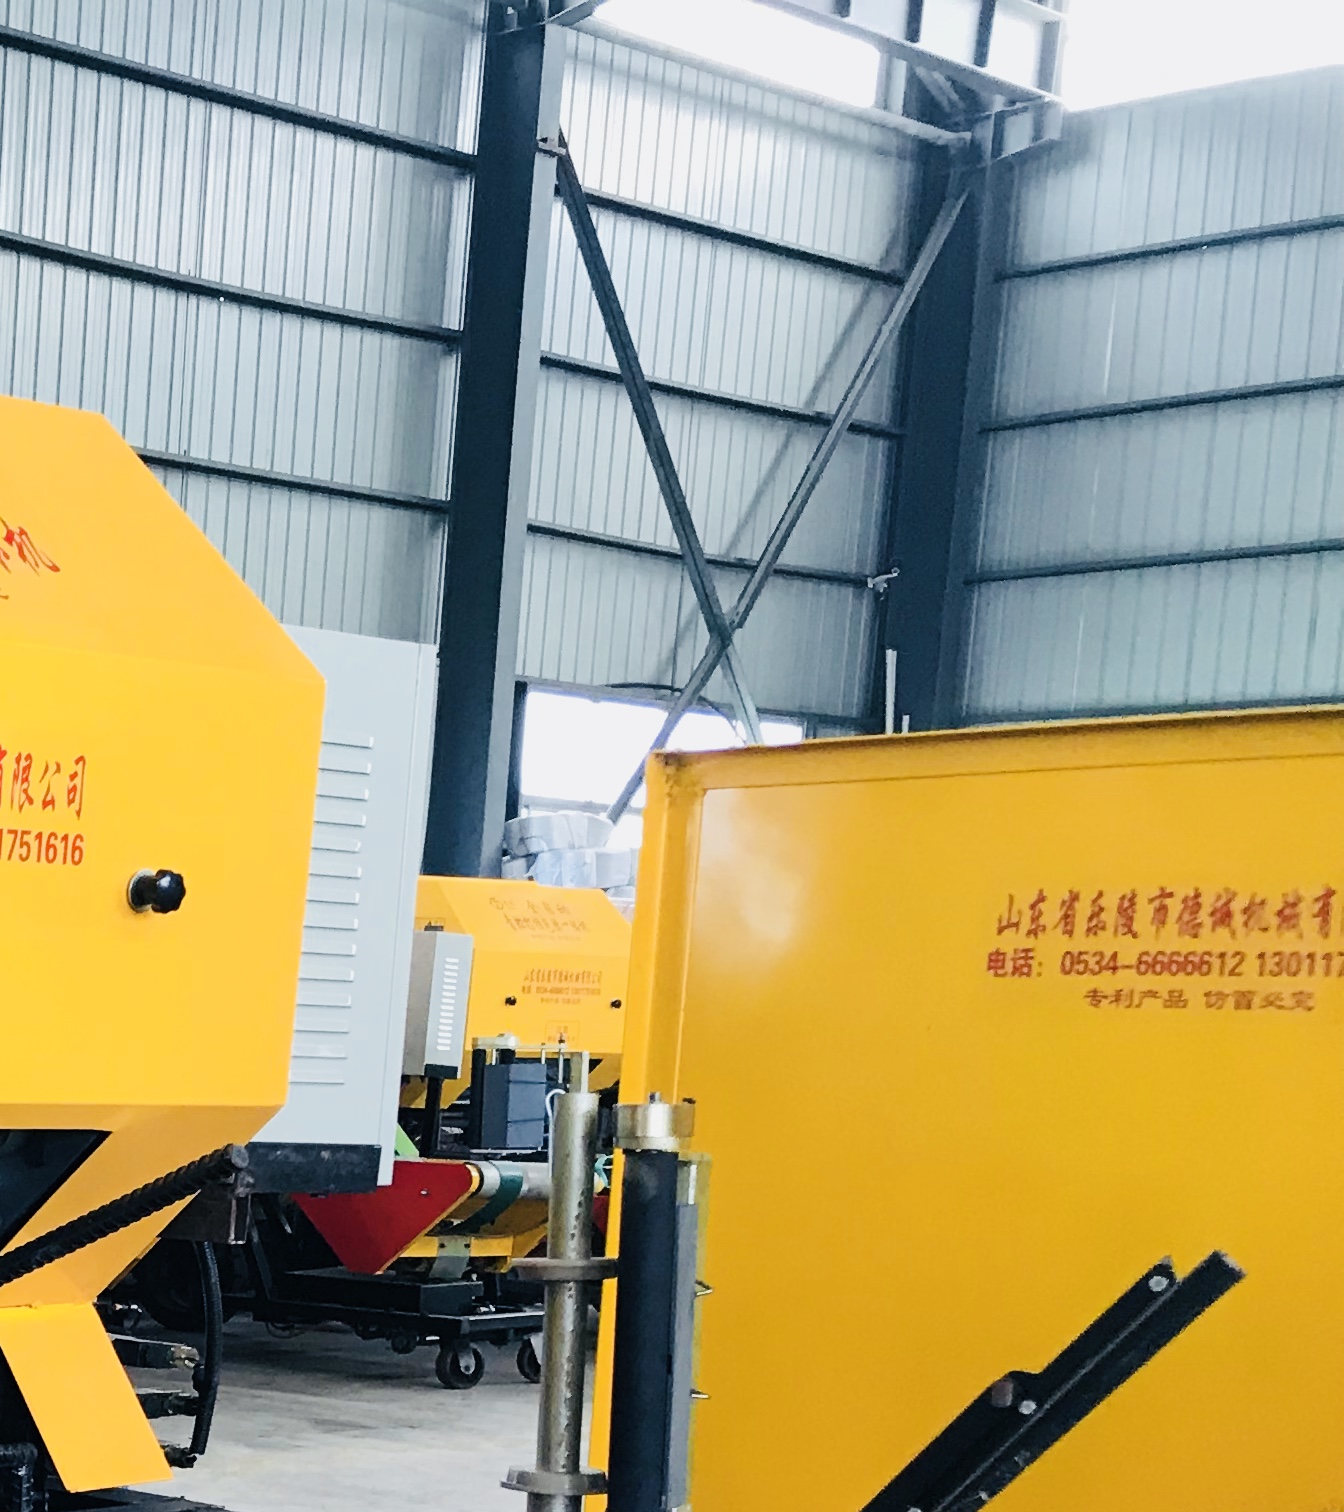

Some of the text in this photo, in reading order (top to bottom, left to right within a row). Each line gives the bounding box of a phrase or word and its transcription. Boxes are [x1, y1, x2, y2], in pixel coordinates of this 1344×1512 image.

[997, 885, 1344, 941] 山东省乐陵市德诚机械有
[1060, 950, 1244, 978] 0534-6666612
[1084, 988, 1189, 1010] 专利产品
